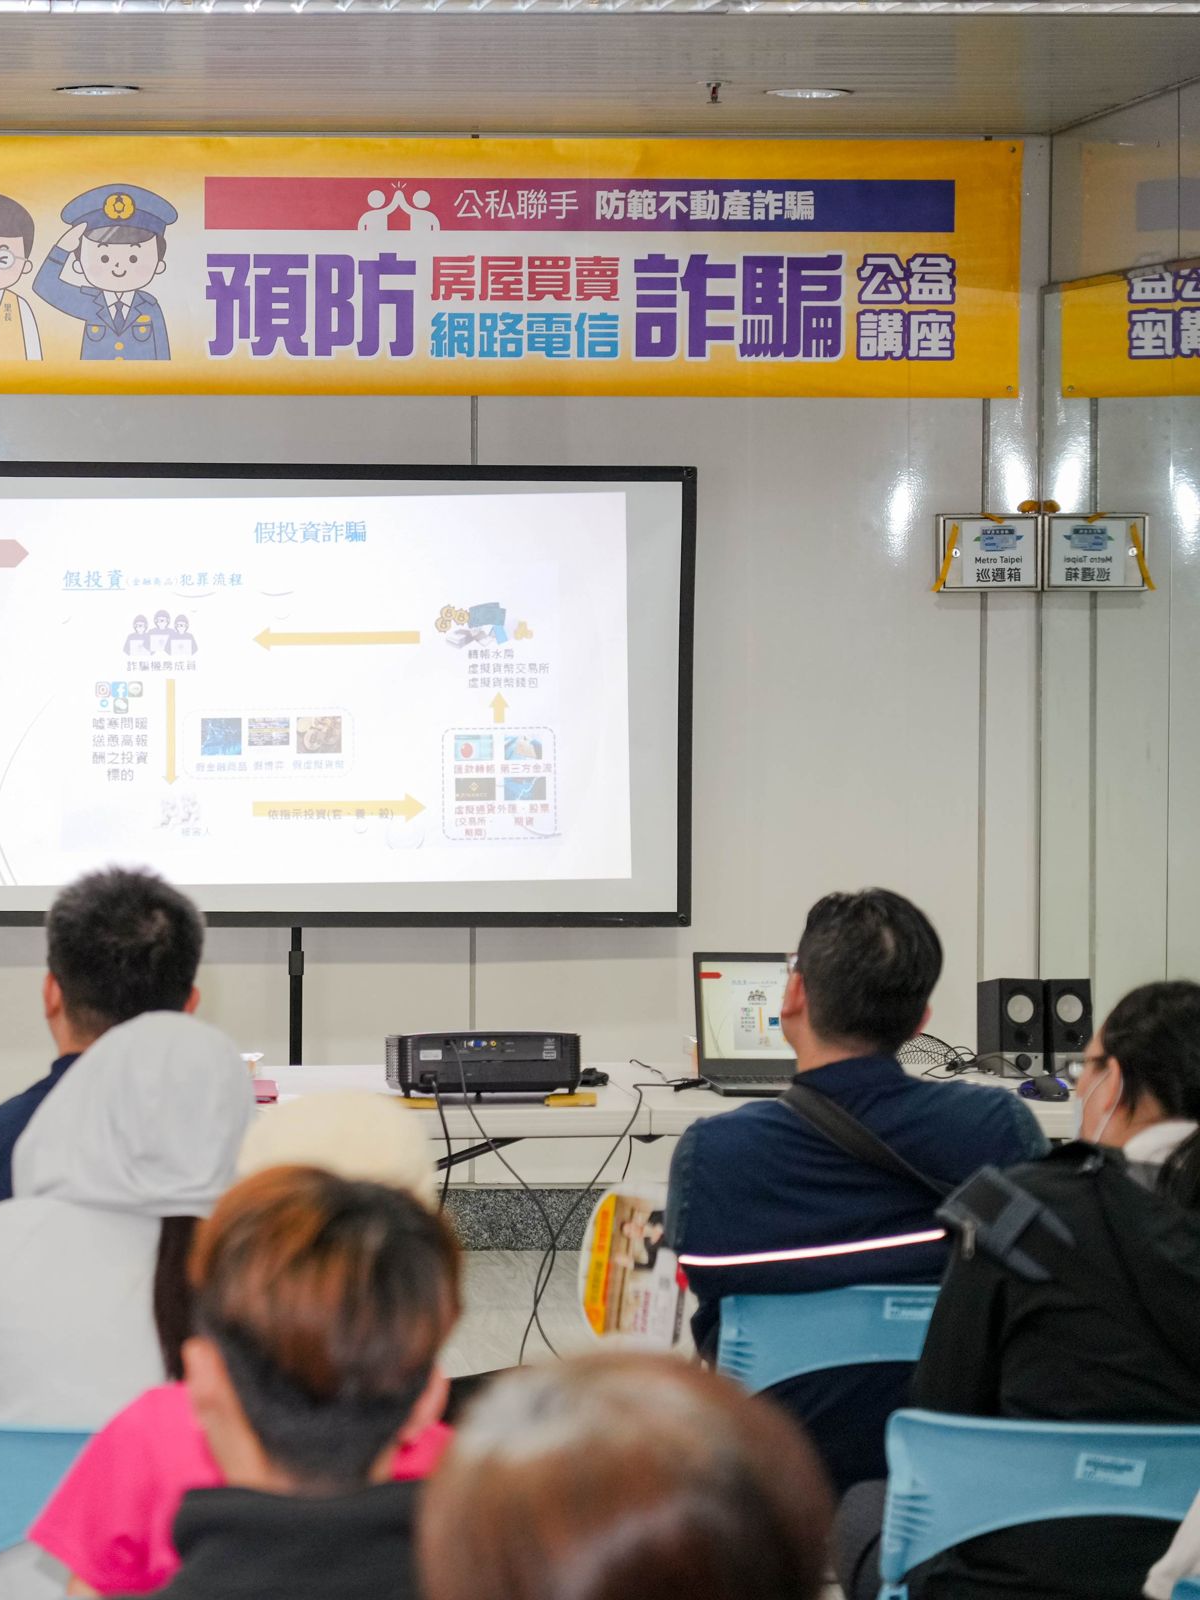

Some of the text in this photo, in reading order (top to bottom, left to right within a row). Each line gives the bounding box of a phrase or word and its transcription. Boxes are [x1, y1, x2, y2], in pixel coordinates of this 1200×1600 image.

[453, 189, 815, 222] 公私聯手 防範不動產詐騙
[430, 255, 620, 302] 房屋買賣
[858, 254, 955, 303] 公益
[205, 252, 417, 358] 預防
[633, 253, 843, 359] 詐騙
[430, 312, 619, 359] 網路電信
[858, 309, 955, 359] 講座
[254, 520, 367, 544] 假投資詐騙
[974, 555, 1023, 565] Metro Taipei
[976, 567, 1021, 583] 巡邏箱
[126, 660, 197, 672] 詐騙機房成員
[467, 663, 550, 674] 虛擬貨幣交易所
[92, 717, 148, 730] 噓寒問暖
[92, 751, 148, 765] 酬之投資
[106, 768, 134, 782] 標的
